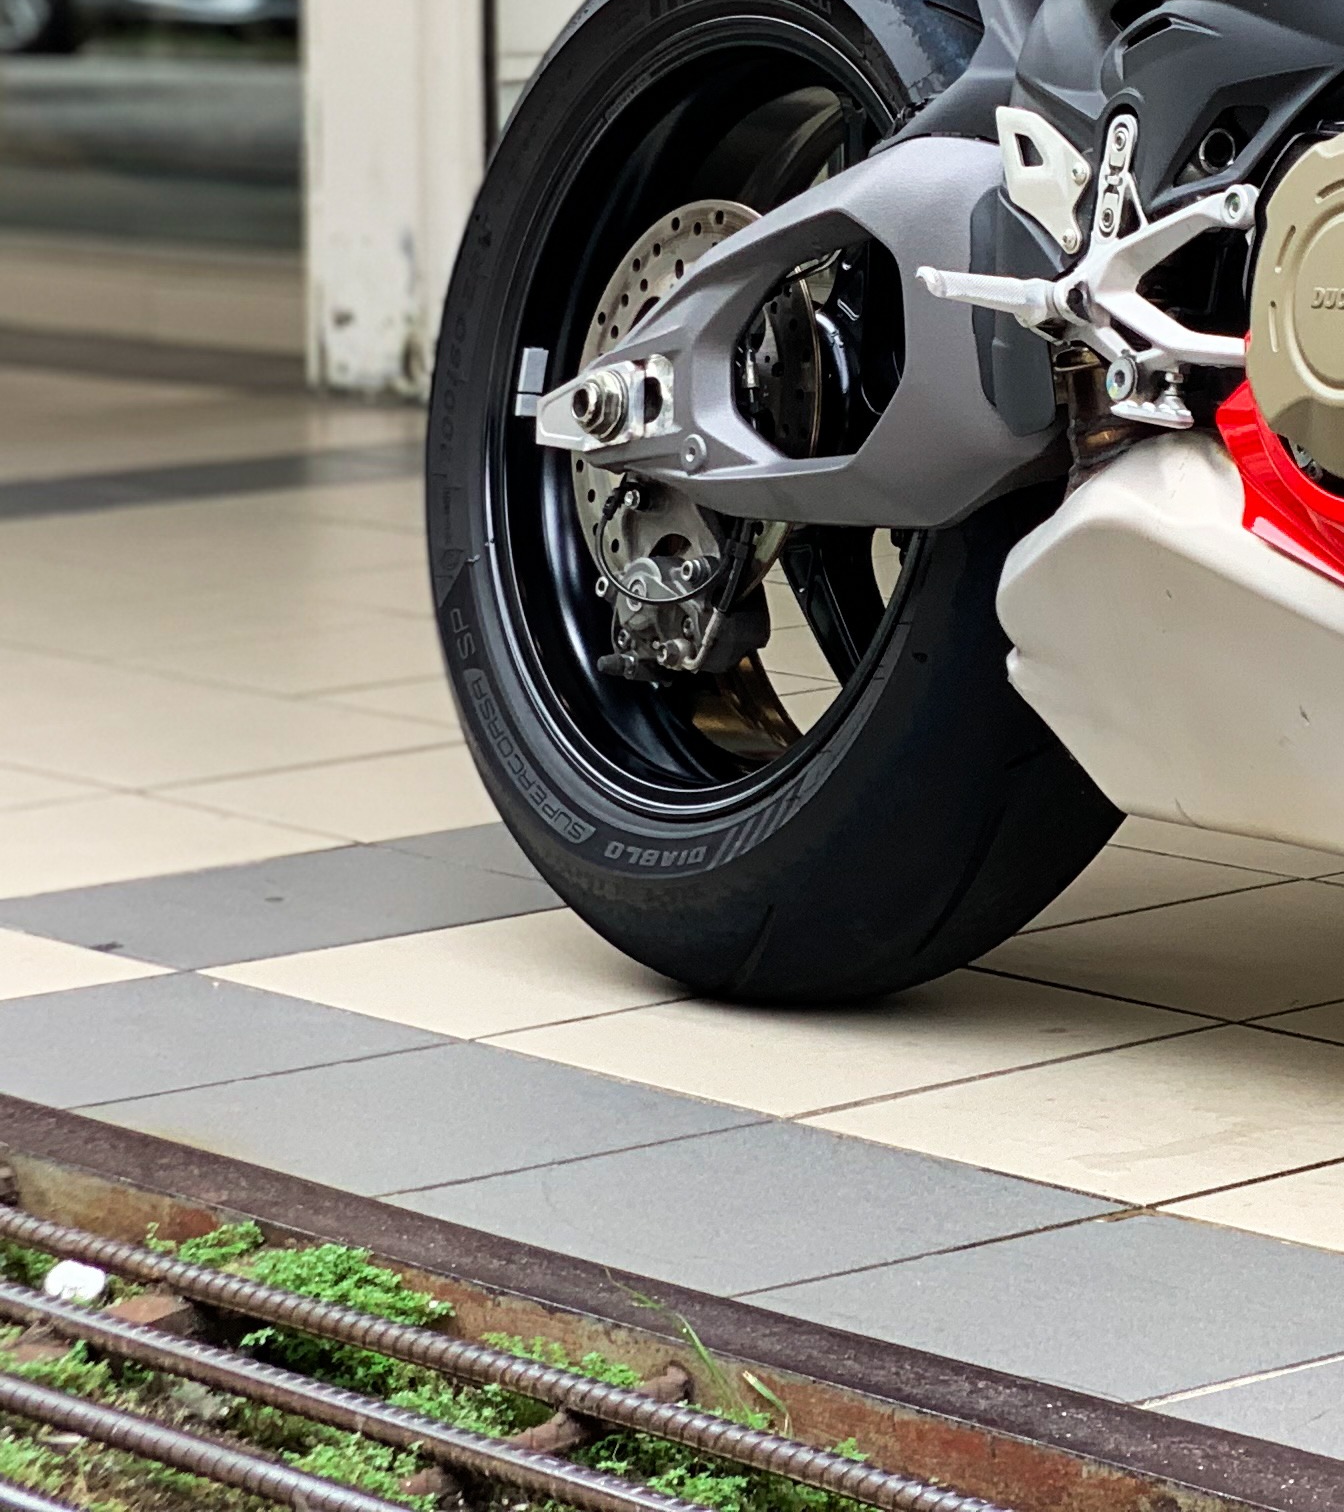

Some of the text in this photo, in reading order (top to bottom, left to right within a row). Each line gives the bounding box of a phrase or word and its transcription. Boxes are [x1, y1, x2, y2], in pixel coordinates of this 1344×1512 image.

[449, 608, 708, 869] DIABLO SUPERCORSA SP
